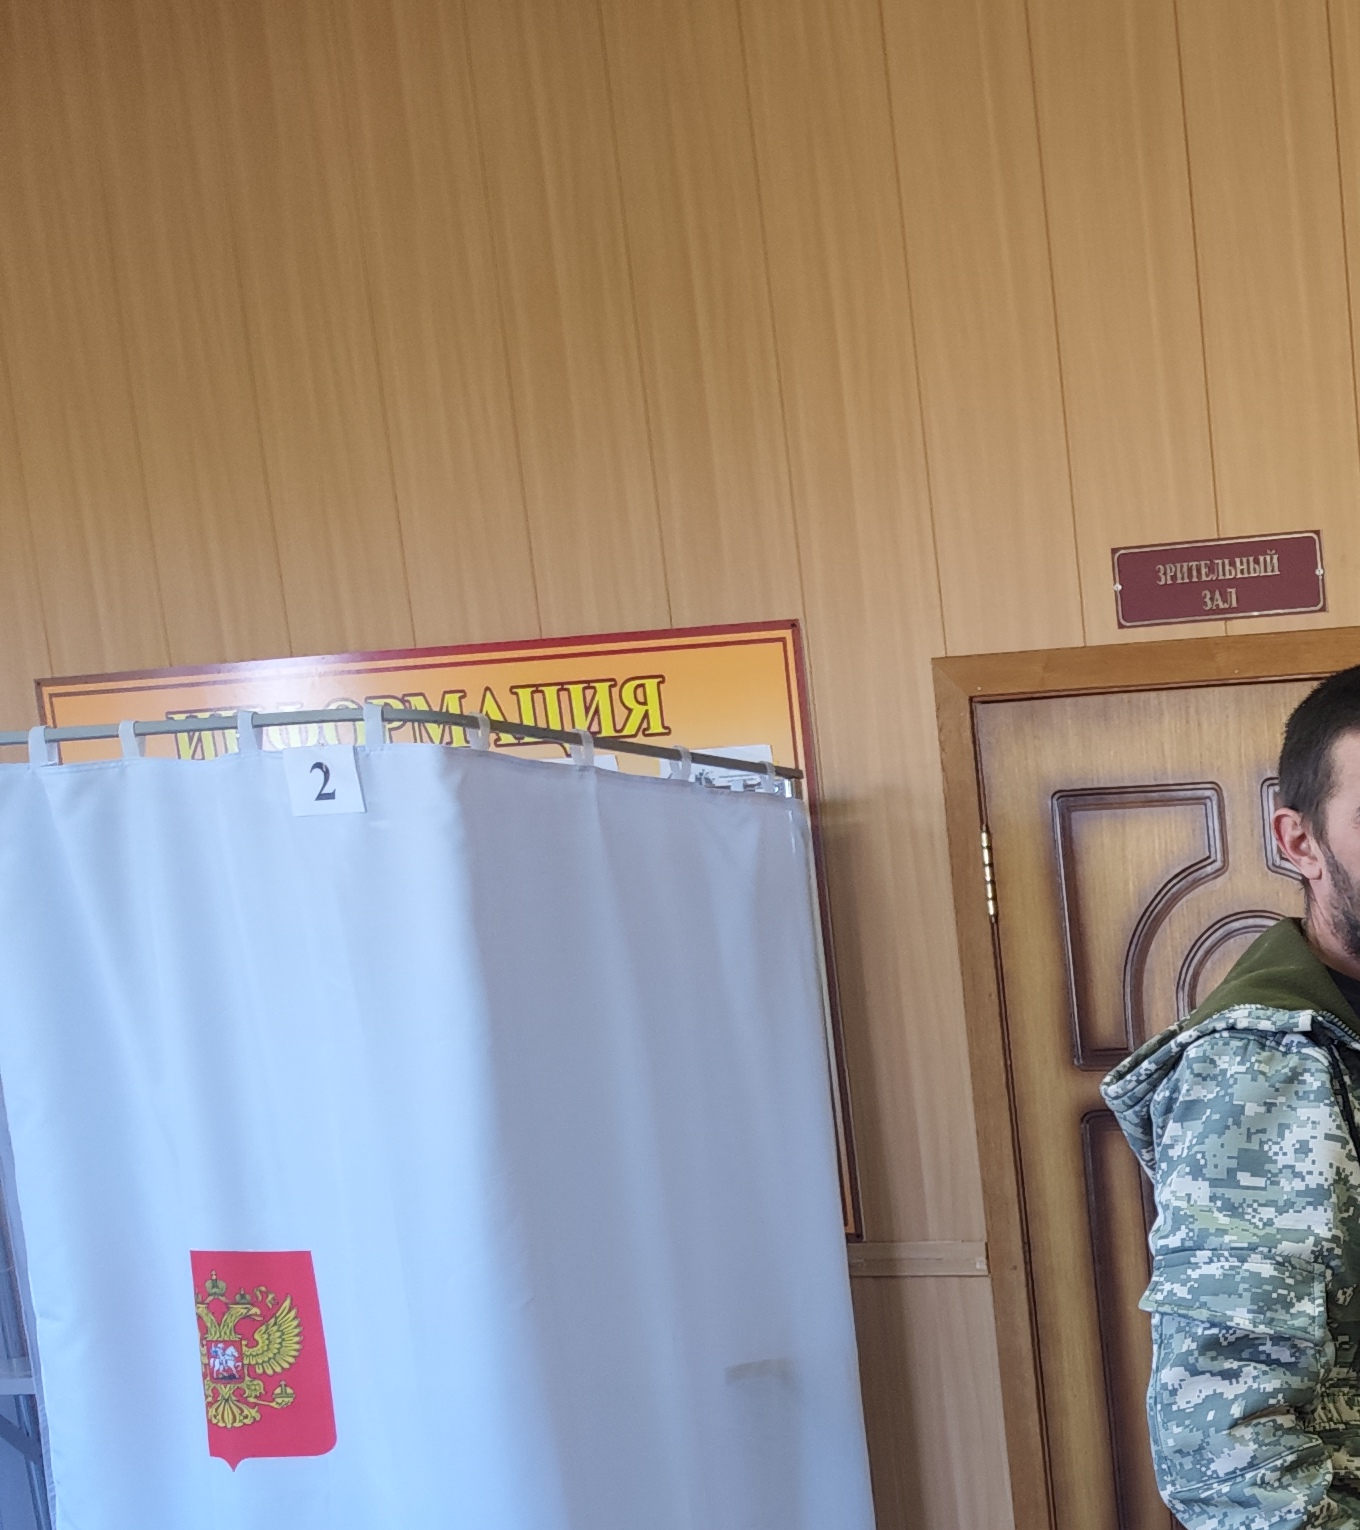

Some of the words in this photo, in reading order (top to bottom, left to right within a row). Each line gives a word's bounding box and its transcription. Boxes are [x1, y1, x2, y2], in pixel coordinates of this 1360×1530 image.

[1156, 549, 1280, 586] ЗРИТЕЛЬНЫЙ
[1202, 588, 1238, 610] ЗАЛ
[309, 761, 336, 801] 2
